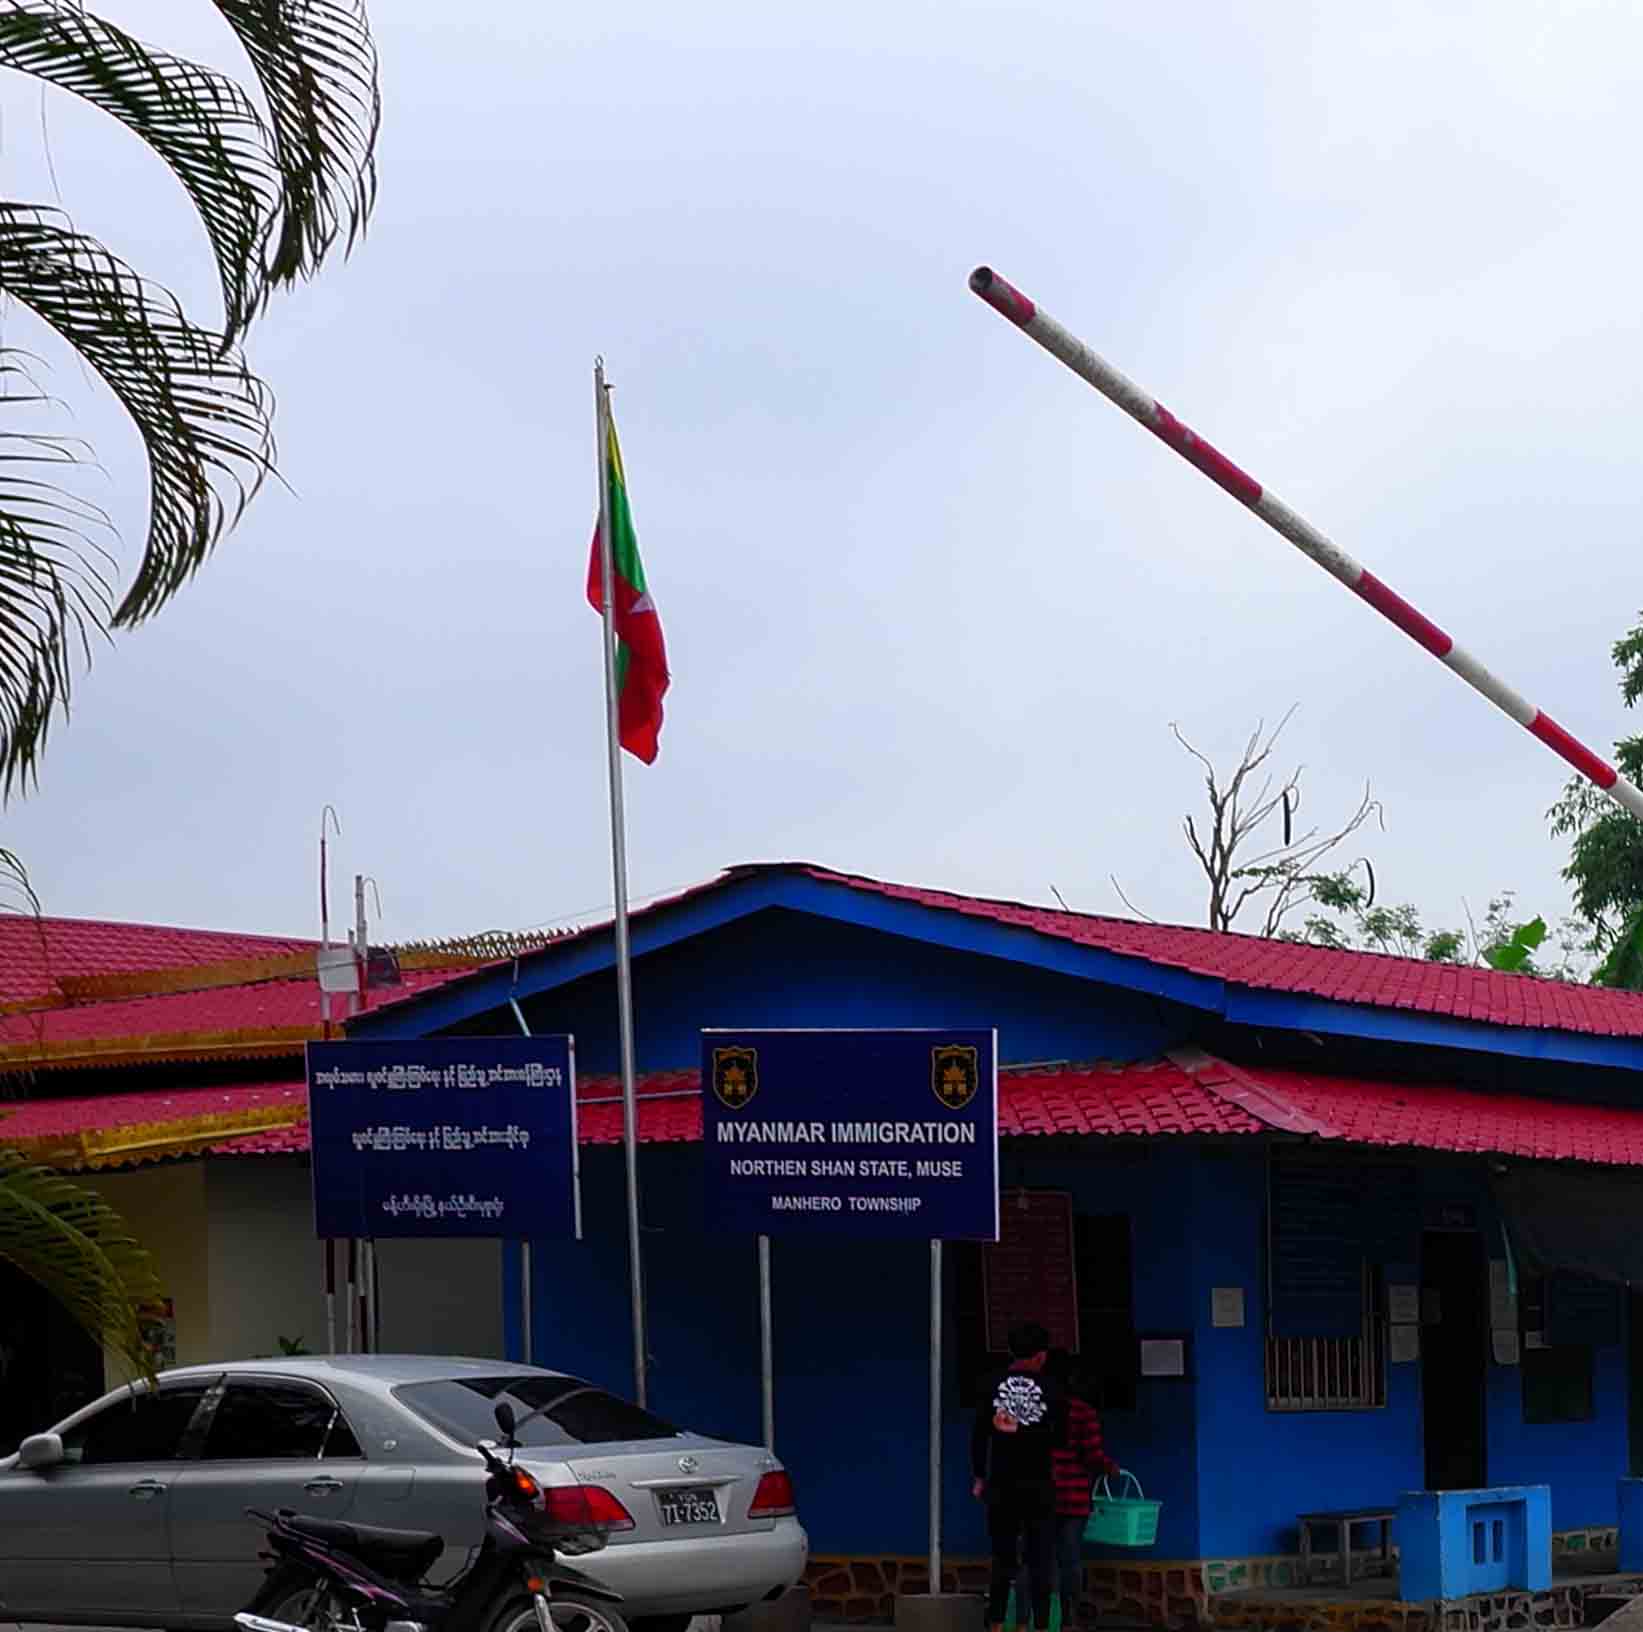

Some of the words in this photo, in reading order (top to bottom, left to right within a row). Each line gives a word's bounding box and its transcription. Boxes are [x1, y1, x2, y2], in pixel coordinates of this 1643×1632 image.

[717, 1122, 825, 1143] MYANMAR
[832, 1122, 975, 1144] IMMIGRATION
[730, 1160, 806, 1176] NORTHEN
[811, 1160, 855, 1177] SHAN
[859, 1160, 912, 1179] STATE,
[916, 1161, 963, 1177] MUSE
[772, 1196, 842, 1212] MANHERO
[848, 1197, 922, 1212] TOWNSHIP
